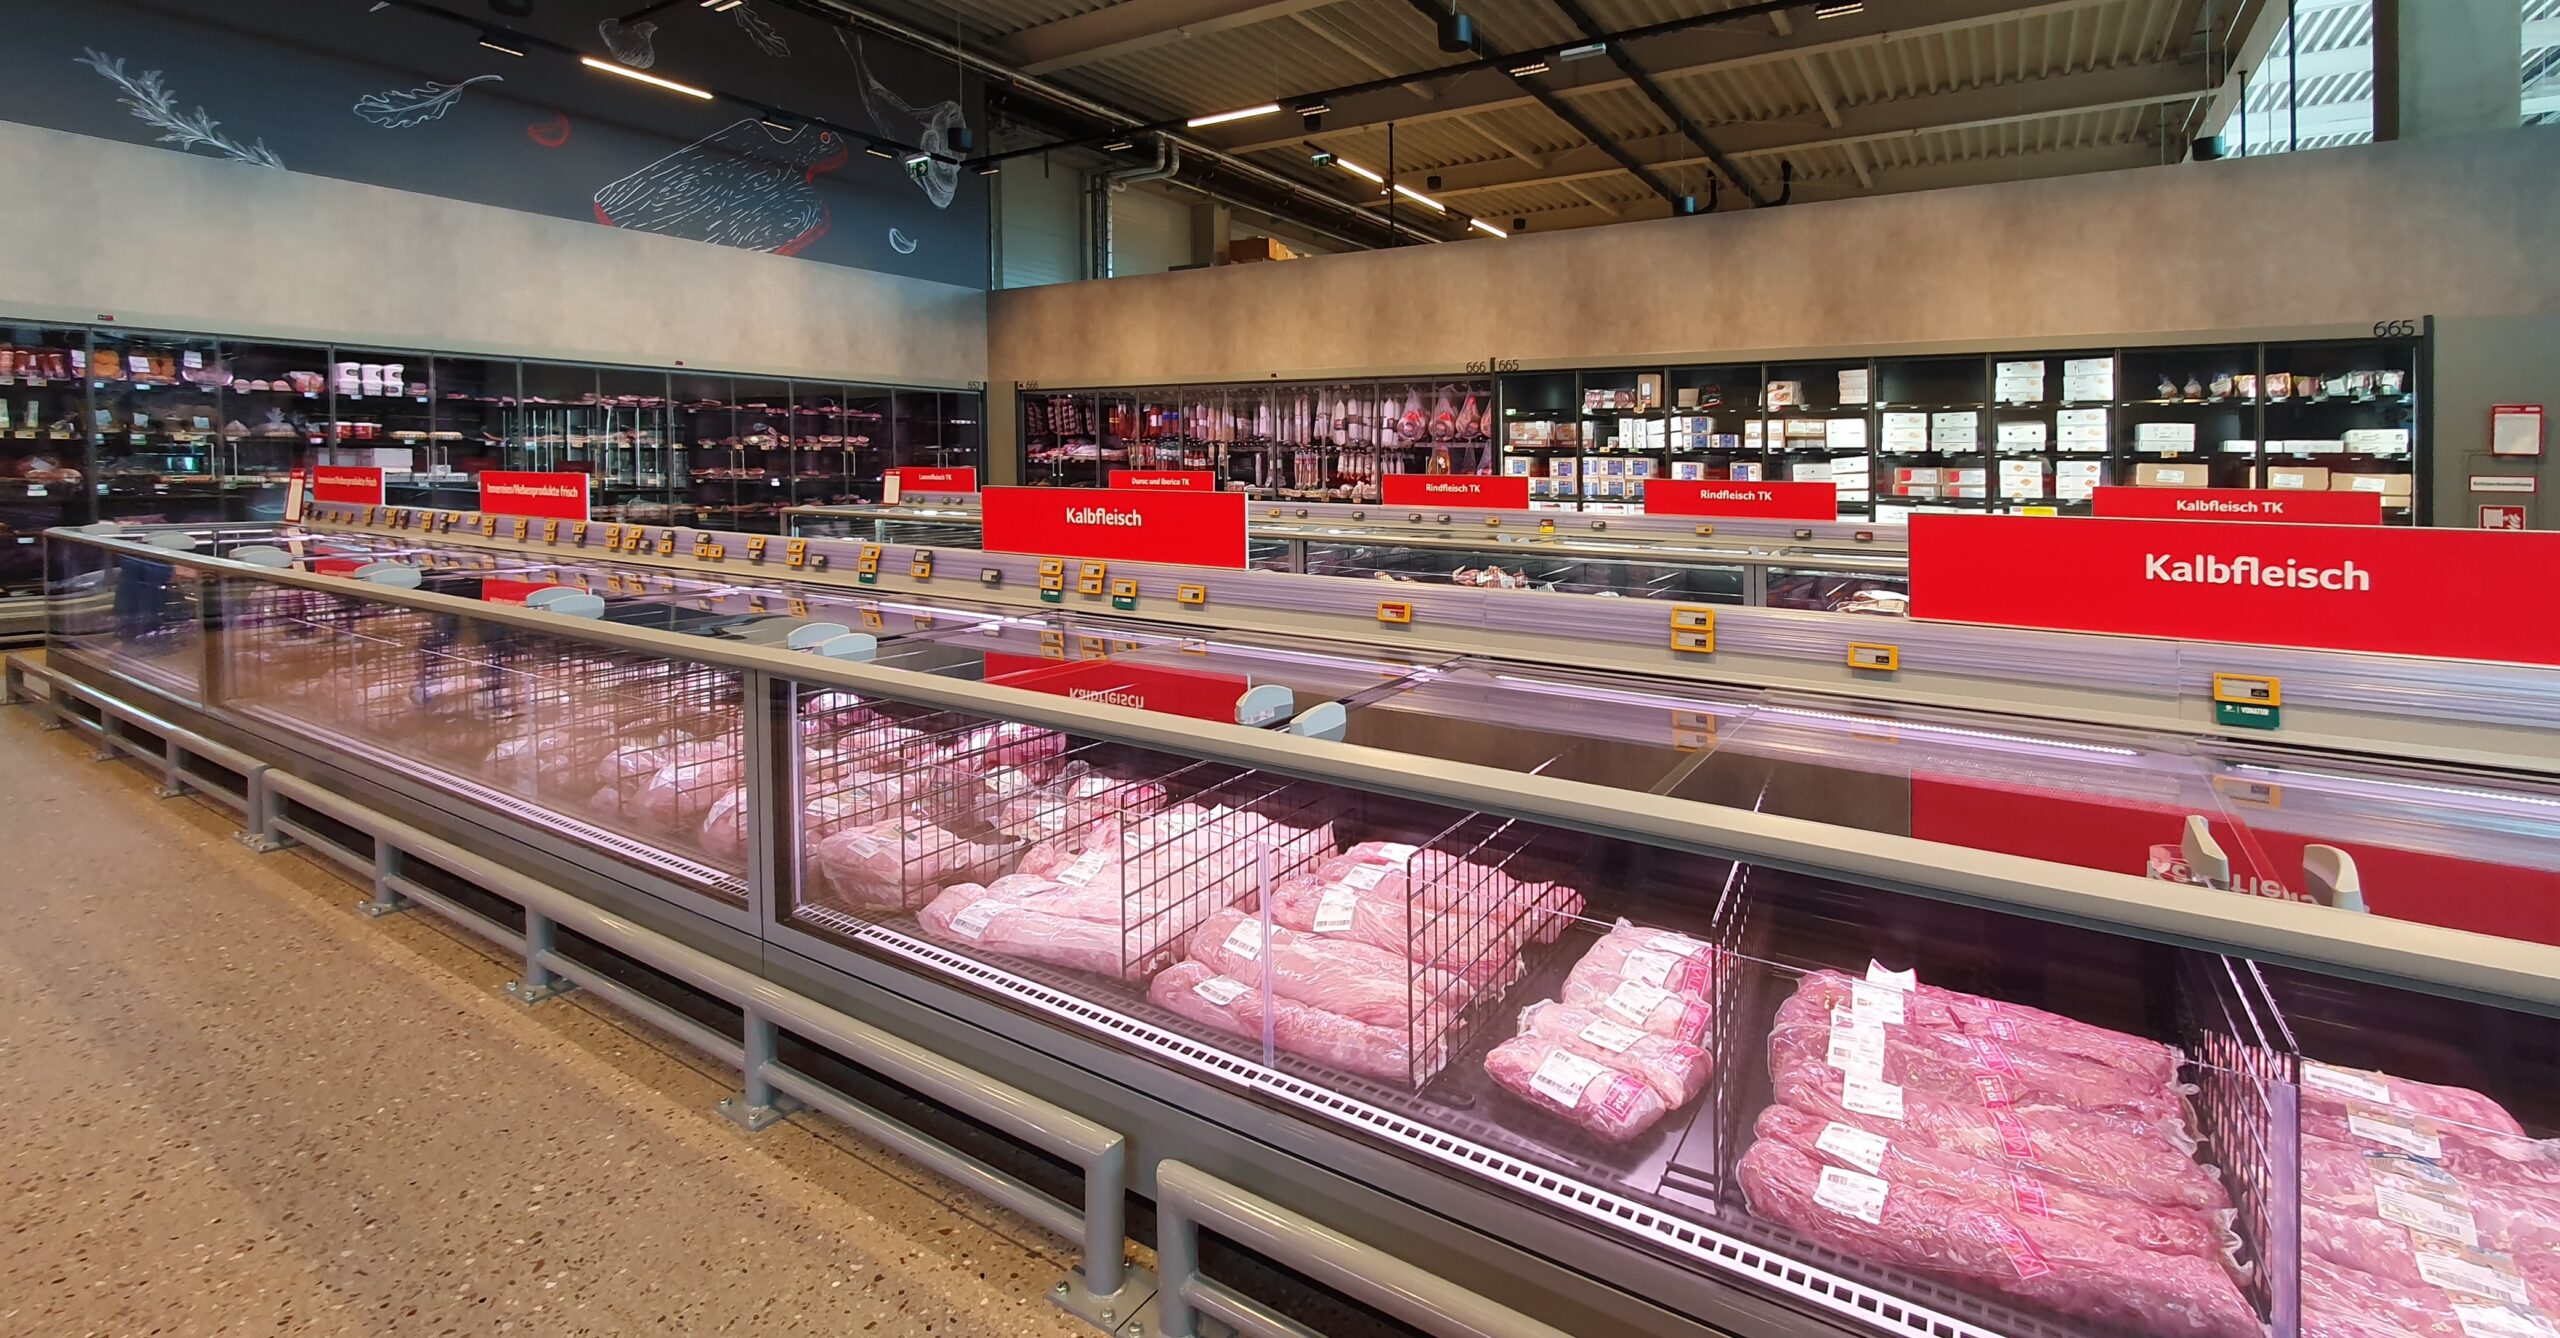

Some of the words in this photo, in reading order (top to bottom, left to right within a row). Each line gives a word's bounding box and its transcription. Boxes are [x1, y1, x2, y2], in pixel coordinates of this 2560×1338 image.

[2373, 320, 2415, 337] 665
[1466, 361, 1486, 373] 666
[1499, 359, 1519, 371] 665
[1131, 477, 1148, 485] Duroc
[1181, 478, 1190, 486] TK
[560, 485, 579, 498] frisch
[1425, 483, 1467, 493] Rindfleisch
[1468, 484, 1481, 493] TK
[1700, 489, 1756, 501] Rindfleisch
[1757, 490, 1772, 501] TK
[2176, 499, 2258, 513] Kalbfleisch
[2261, 501, 2284, 514] TK
[1066, 507, 1142, 526] Kalbfleisch
[2145, 553, 2370, 591] Kalbfleisch
